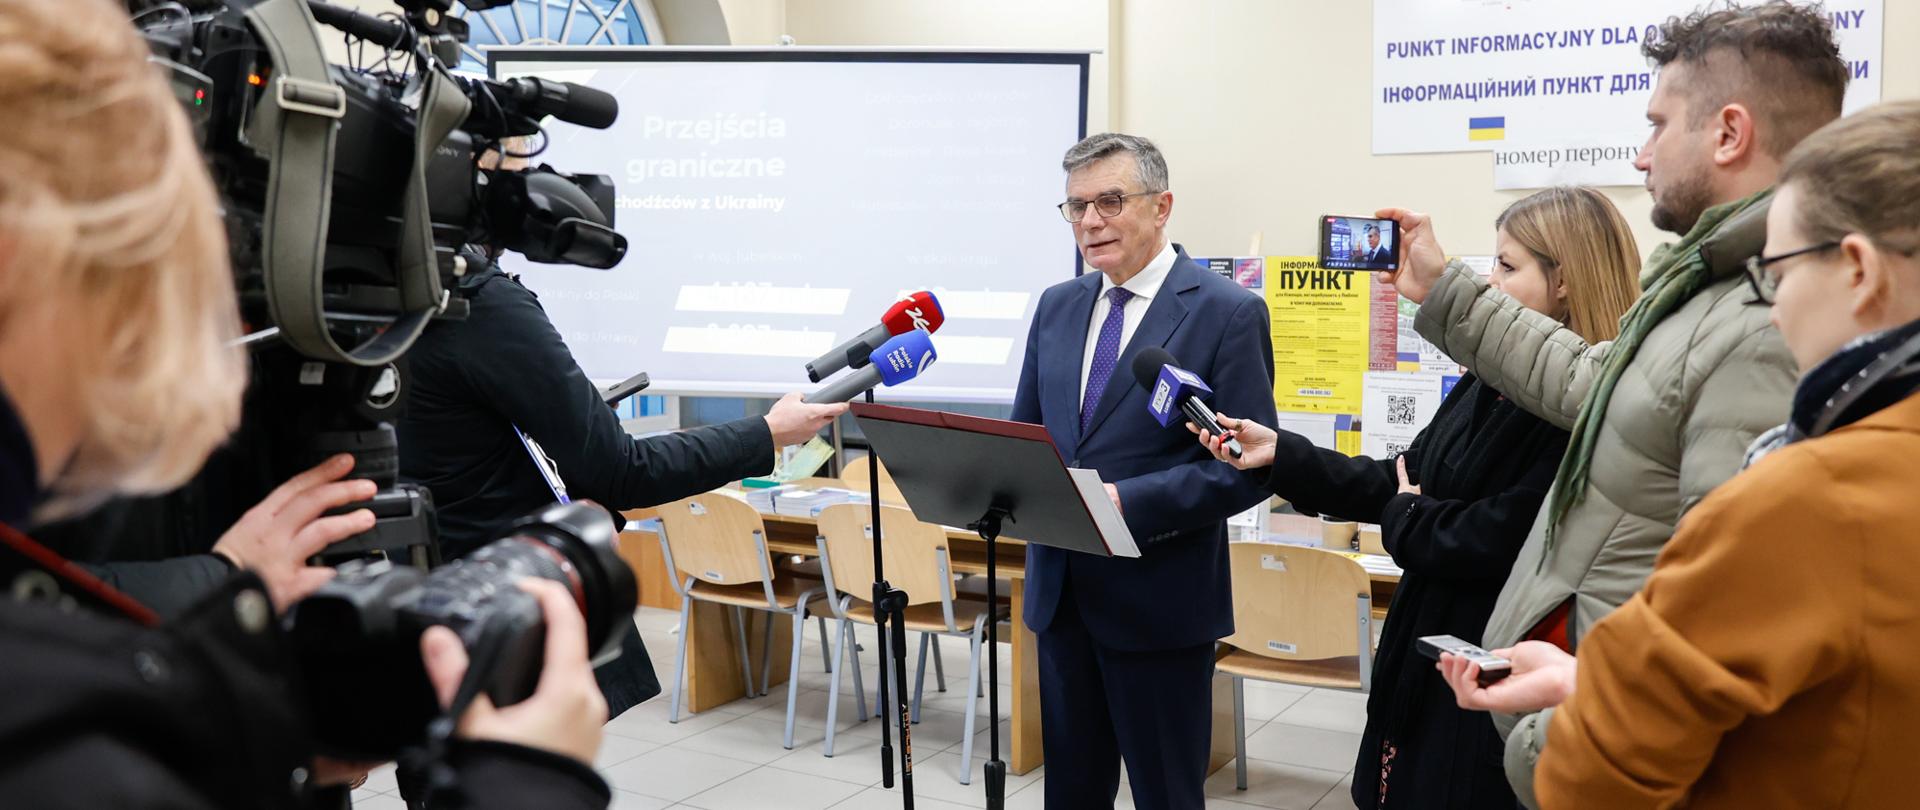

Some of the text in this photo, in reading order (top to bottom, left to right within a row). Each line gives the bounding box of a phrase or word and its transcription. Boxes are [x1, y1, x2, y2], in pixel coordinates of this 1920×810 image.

[1387, 39, 1446, 59] PUNKT
[1451, 28, 1595, 55] INFORMACYJNY
[1602, 26, 1638, 45] DLA
[1383, 73, 1650, 104] ІНФОРМАЦІЙНИЙ ПУНКТ ДЛЯ
[643, 112, 787, 145] Przejścia
[437, 145, 459, 158] ONY
[1495, 149, 1560, 168] номер
[626, 151, 786, 184] graniczne
[615, 194, 785, 212] chodźców z Ukrainy
[1280, 261, 1320, 270] ІНФОРМА
[1280, 270, 1355, 290] ПУНКТ
